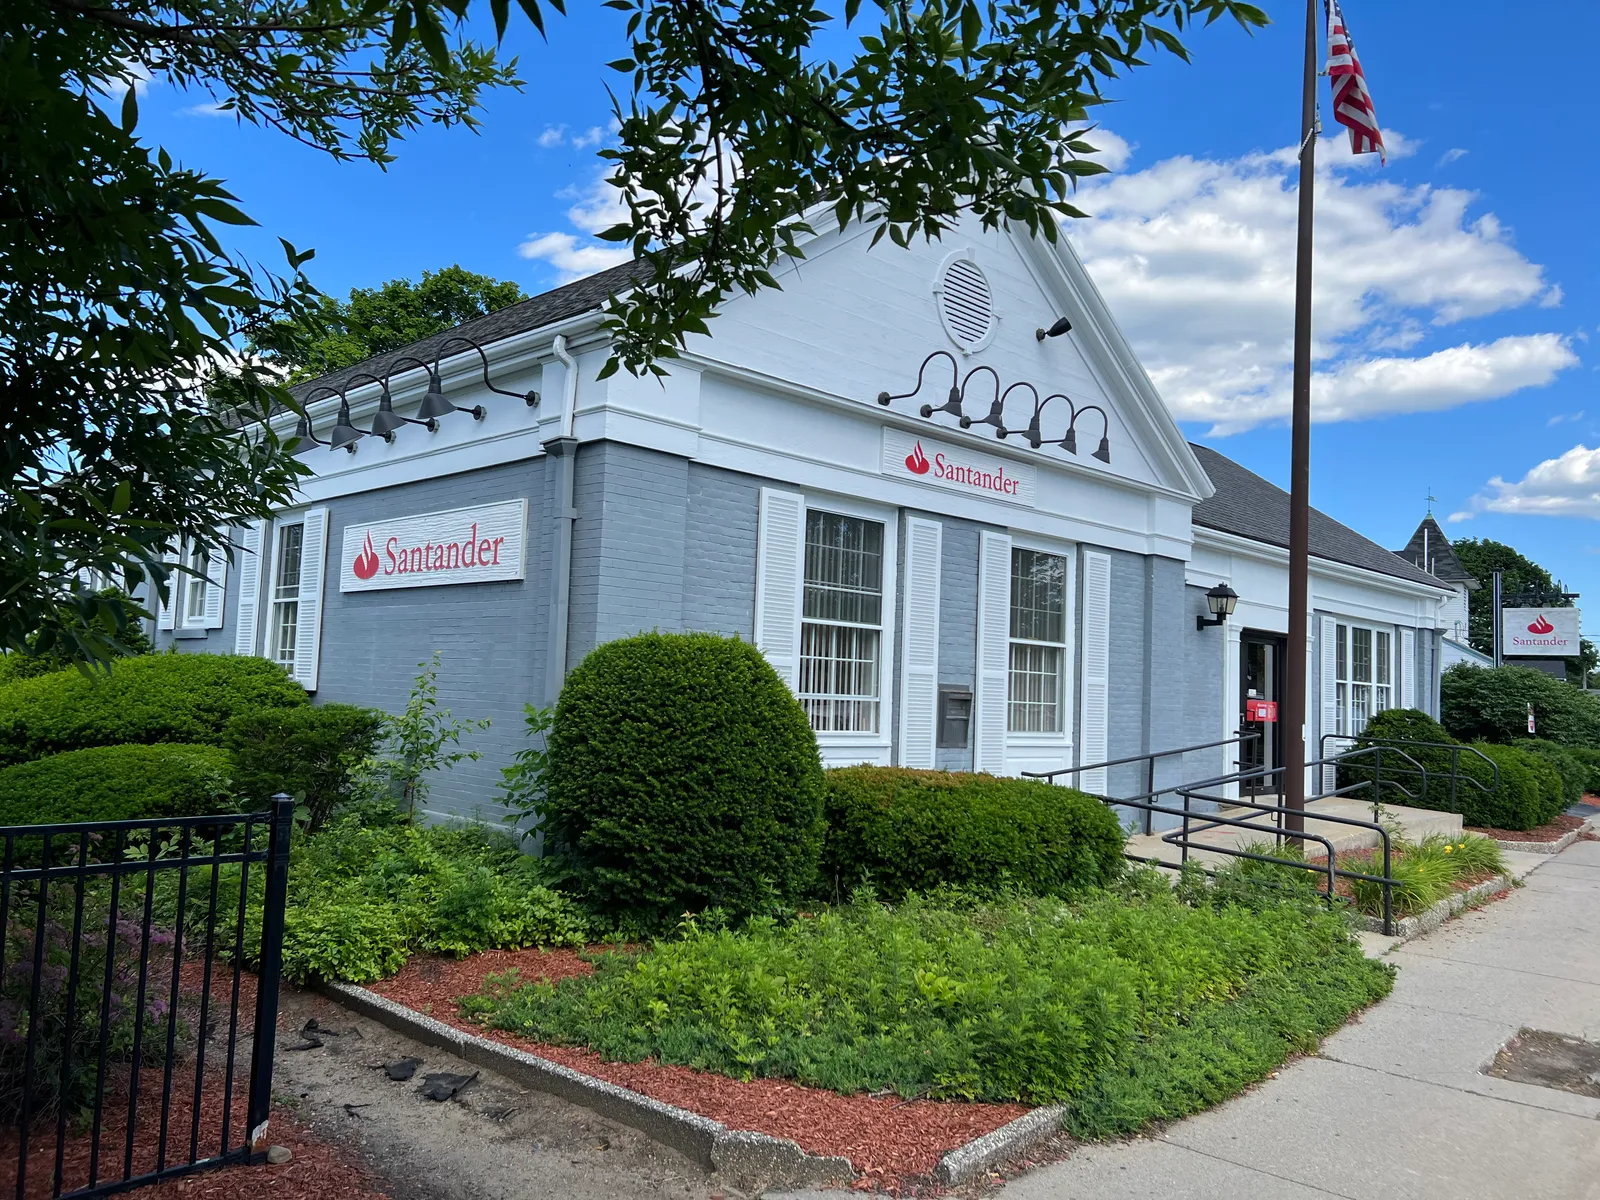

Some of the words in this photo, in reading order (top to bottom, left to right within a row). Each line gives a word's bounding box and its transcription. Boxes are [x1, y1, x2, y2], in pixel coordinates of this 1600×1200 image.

[934, 453, 1019, 495] Santander
[384, 522, 504, 575] Santander
[1513, 636, 1568, 646] Santander
